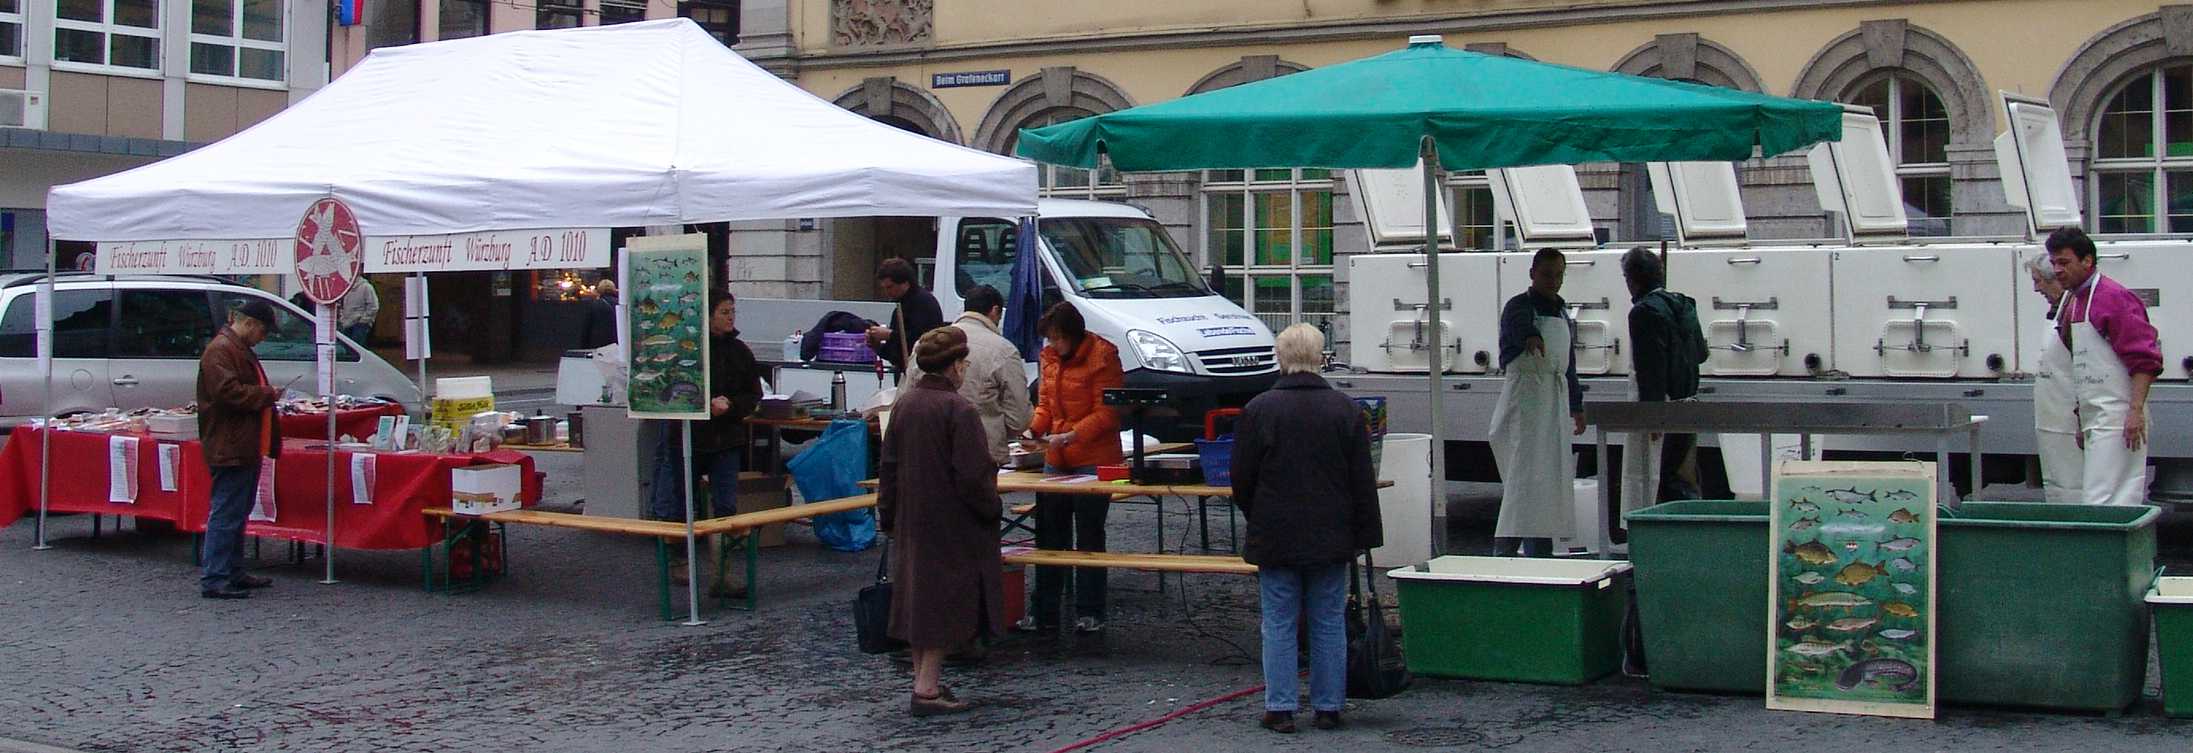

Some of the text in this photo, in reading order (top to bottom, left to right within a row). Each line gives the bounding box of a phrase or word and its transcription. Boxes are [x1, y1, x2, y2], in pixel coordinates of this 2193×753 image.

[936, 75, 955, 86] Beim
[110, 241, 167, 273] Fischerzunft
[178, 242, 217, 273] Würzburg
[255, 240, 278, 267] 1010
[383, 234, 453, 269] Fischerzunft
[466, 234, 512, 270] Würzburg
[560, 231, 586, 262] 1010
[1834, 252, 1840, 260] 2
